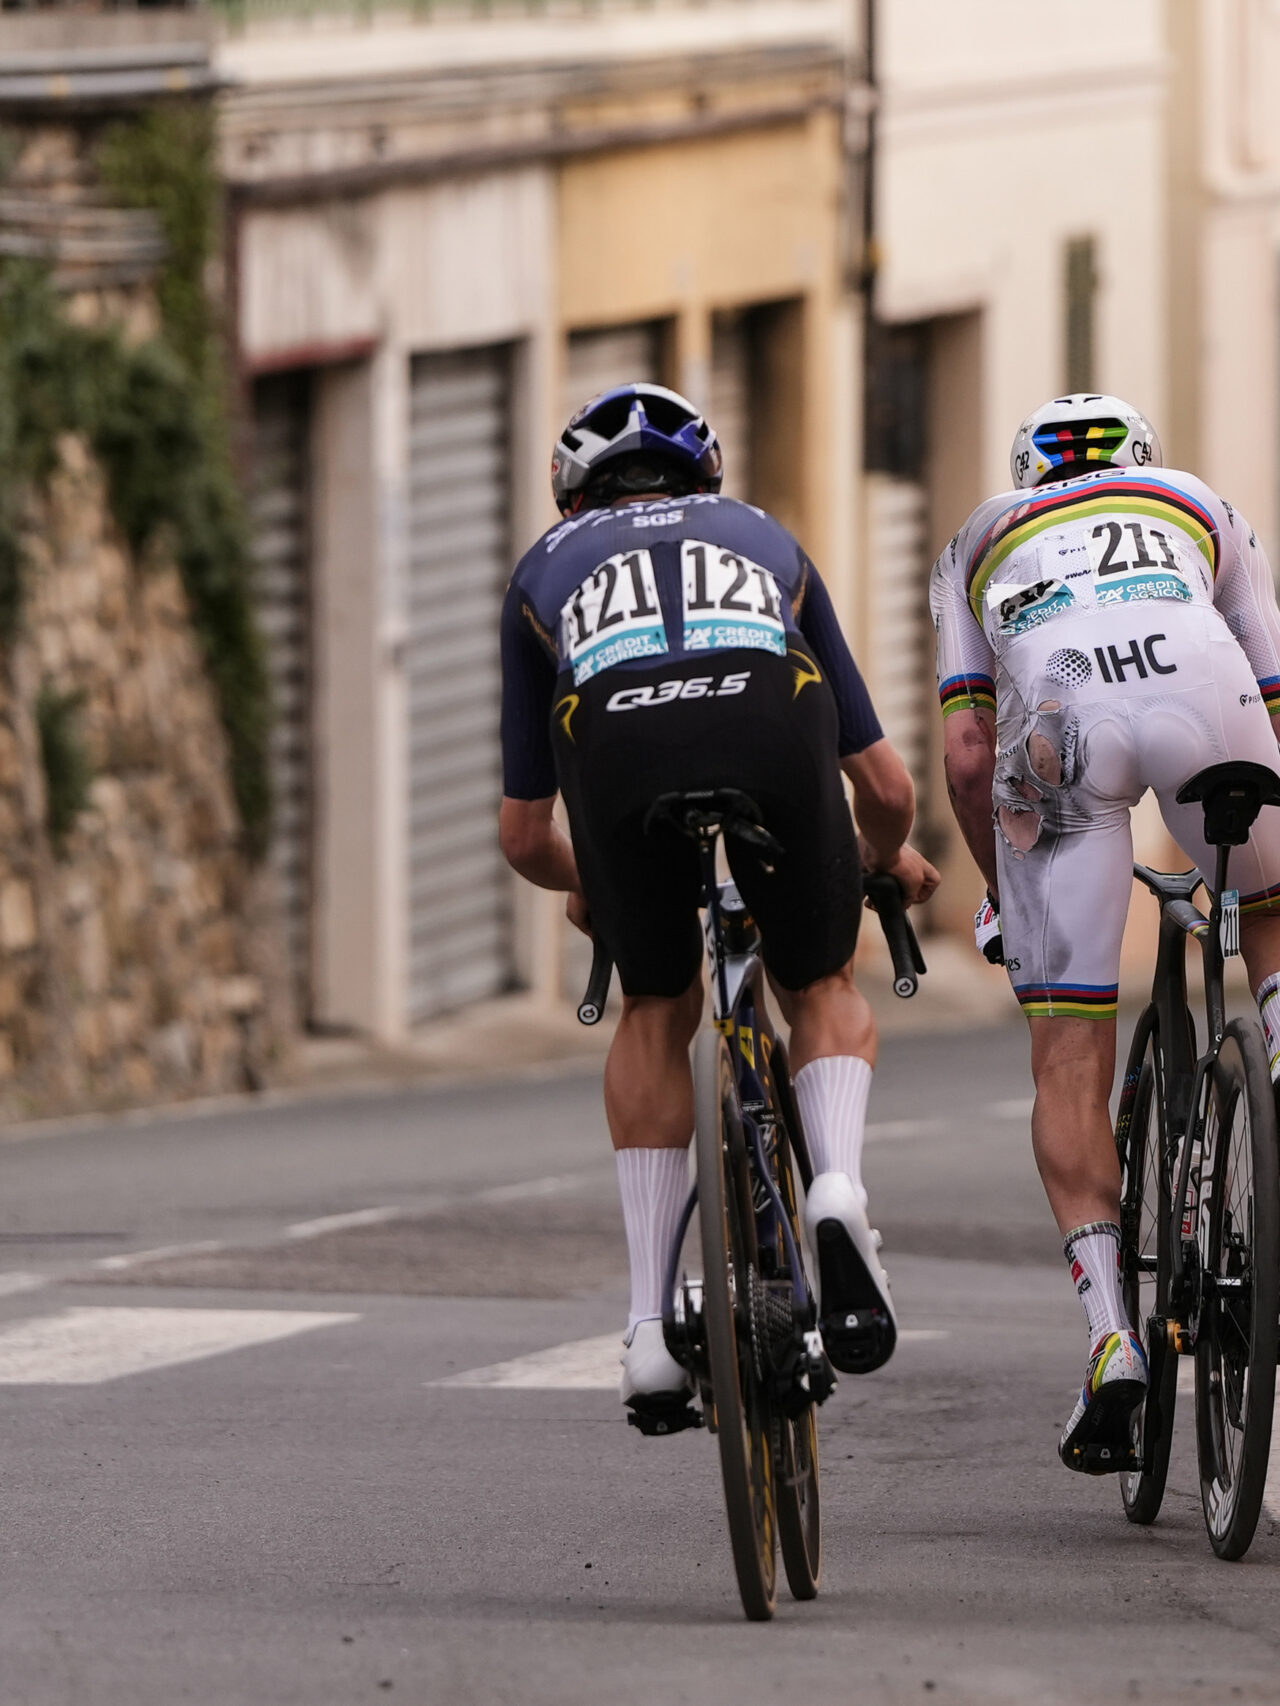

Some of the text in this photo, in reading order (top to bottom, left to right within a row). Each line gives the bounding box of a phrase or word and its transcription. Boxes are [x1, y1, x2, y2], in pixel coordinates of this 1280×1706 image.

[632, 510, 684, 528] SGS
[1091, 521, 1180, 577] 211
[573, 553, 658, 647] 121
[687, 546, 782, 622] 121
[1126, 581, 1178, 593] CRÉDIT
[1094, 634, 1178, 684] IHC
[606, 671, 751, 712] Q36.5
[1223, 906, 1239, 957] 211
